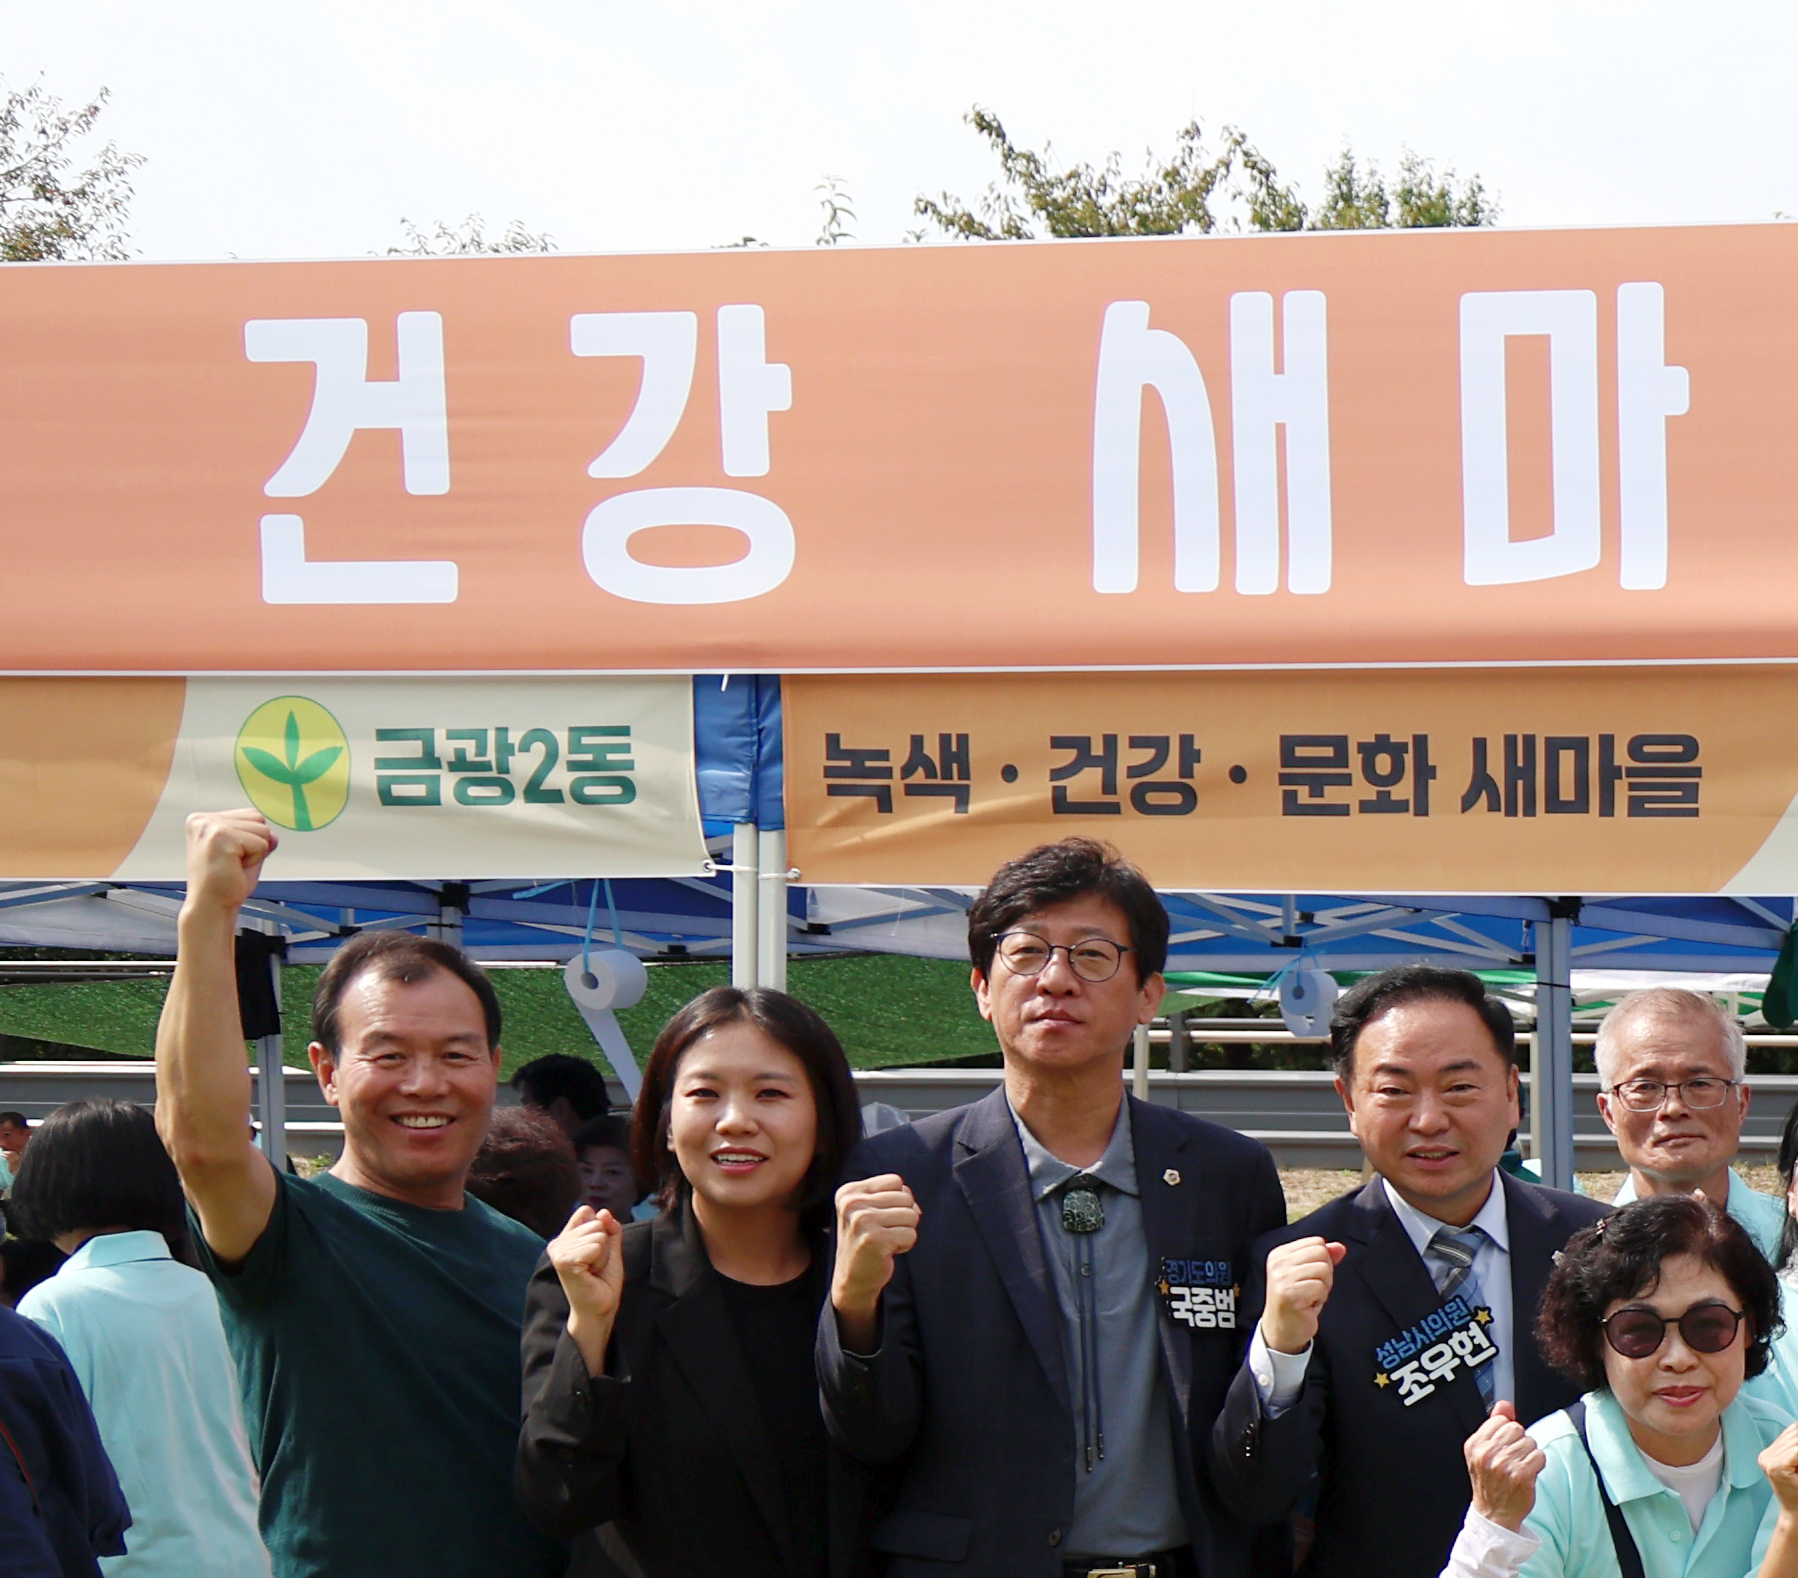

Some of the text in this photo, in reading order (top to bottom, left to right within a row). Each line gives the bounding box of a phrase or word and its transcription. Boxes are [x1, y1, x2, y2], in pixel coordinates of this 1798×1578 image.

[244, 303, 797, 605] 건강
[379, 725, 637, 807] 금광2동
[823, 733, 971, 814] 녹색
[1049, 734, 1202, 816] 건강
[1278, 734, 1437, 817] 문화
[1461, 734, 1703, 818] 새마을
[1165, 1259, 1232, 1286] 경기도의원
[1169, 1286, 1236, 1329] 국중범
[1375, 1297, 1472, 1370] 성남시의원
[1389, 1321, 1498, 1407] 조우현
